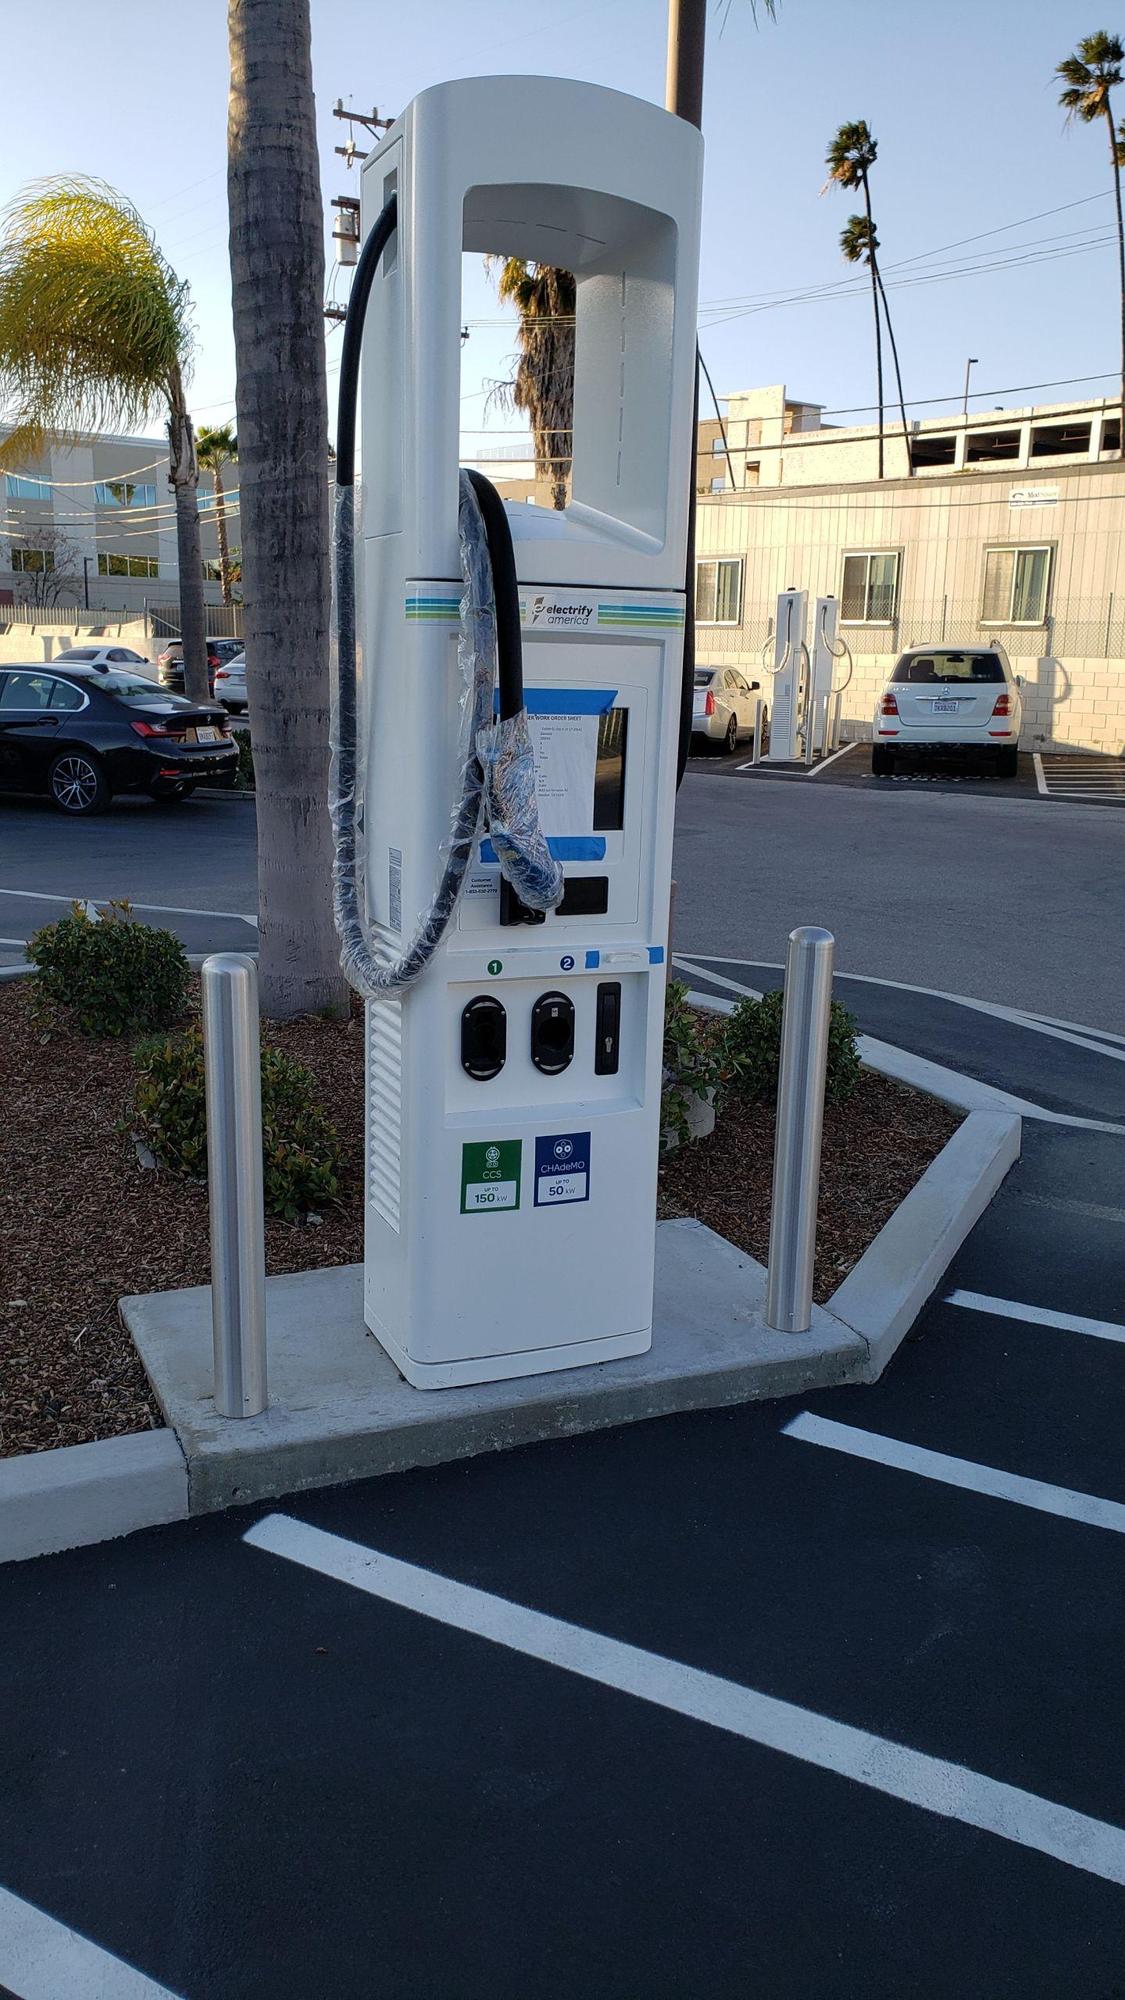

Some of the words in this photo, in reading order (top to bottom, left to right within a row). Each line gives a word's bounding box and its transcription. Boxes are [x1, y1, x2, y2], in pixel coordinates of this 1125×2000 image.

[546, 605, 593, 617] electrify
[547, 616, 589, 625] america
[563, 958, 571, 969] 2
[540, 1161, 585, 1174] CHAdeMO
[482, 1170, 502, 1179] CCS
[549, 1186, 564, 1196] 50
[474, 1193, 495, 1203] 150
